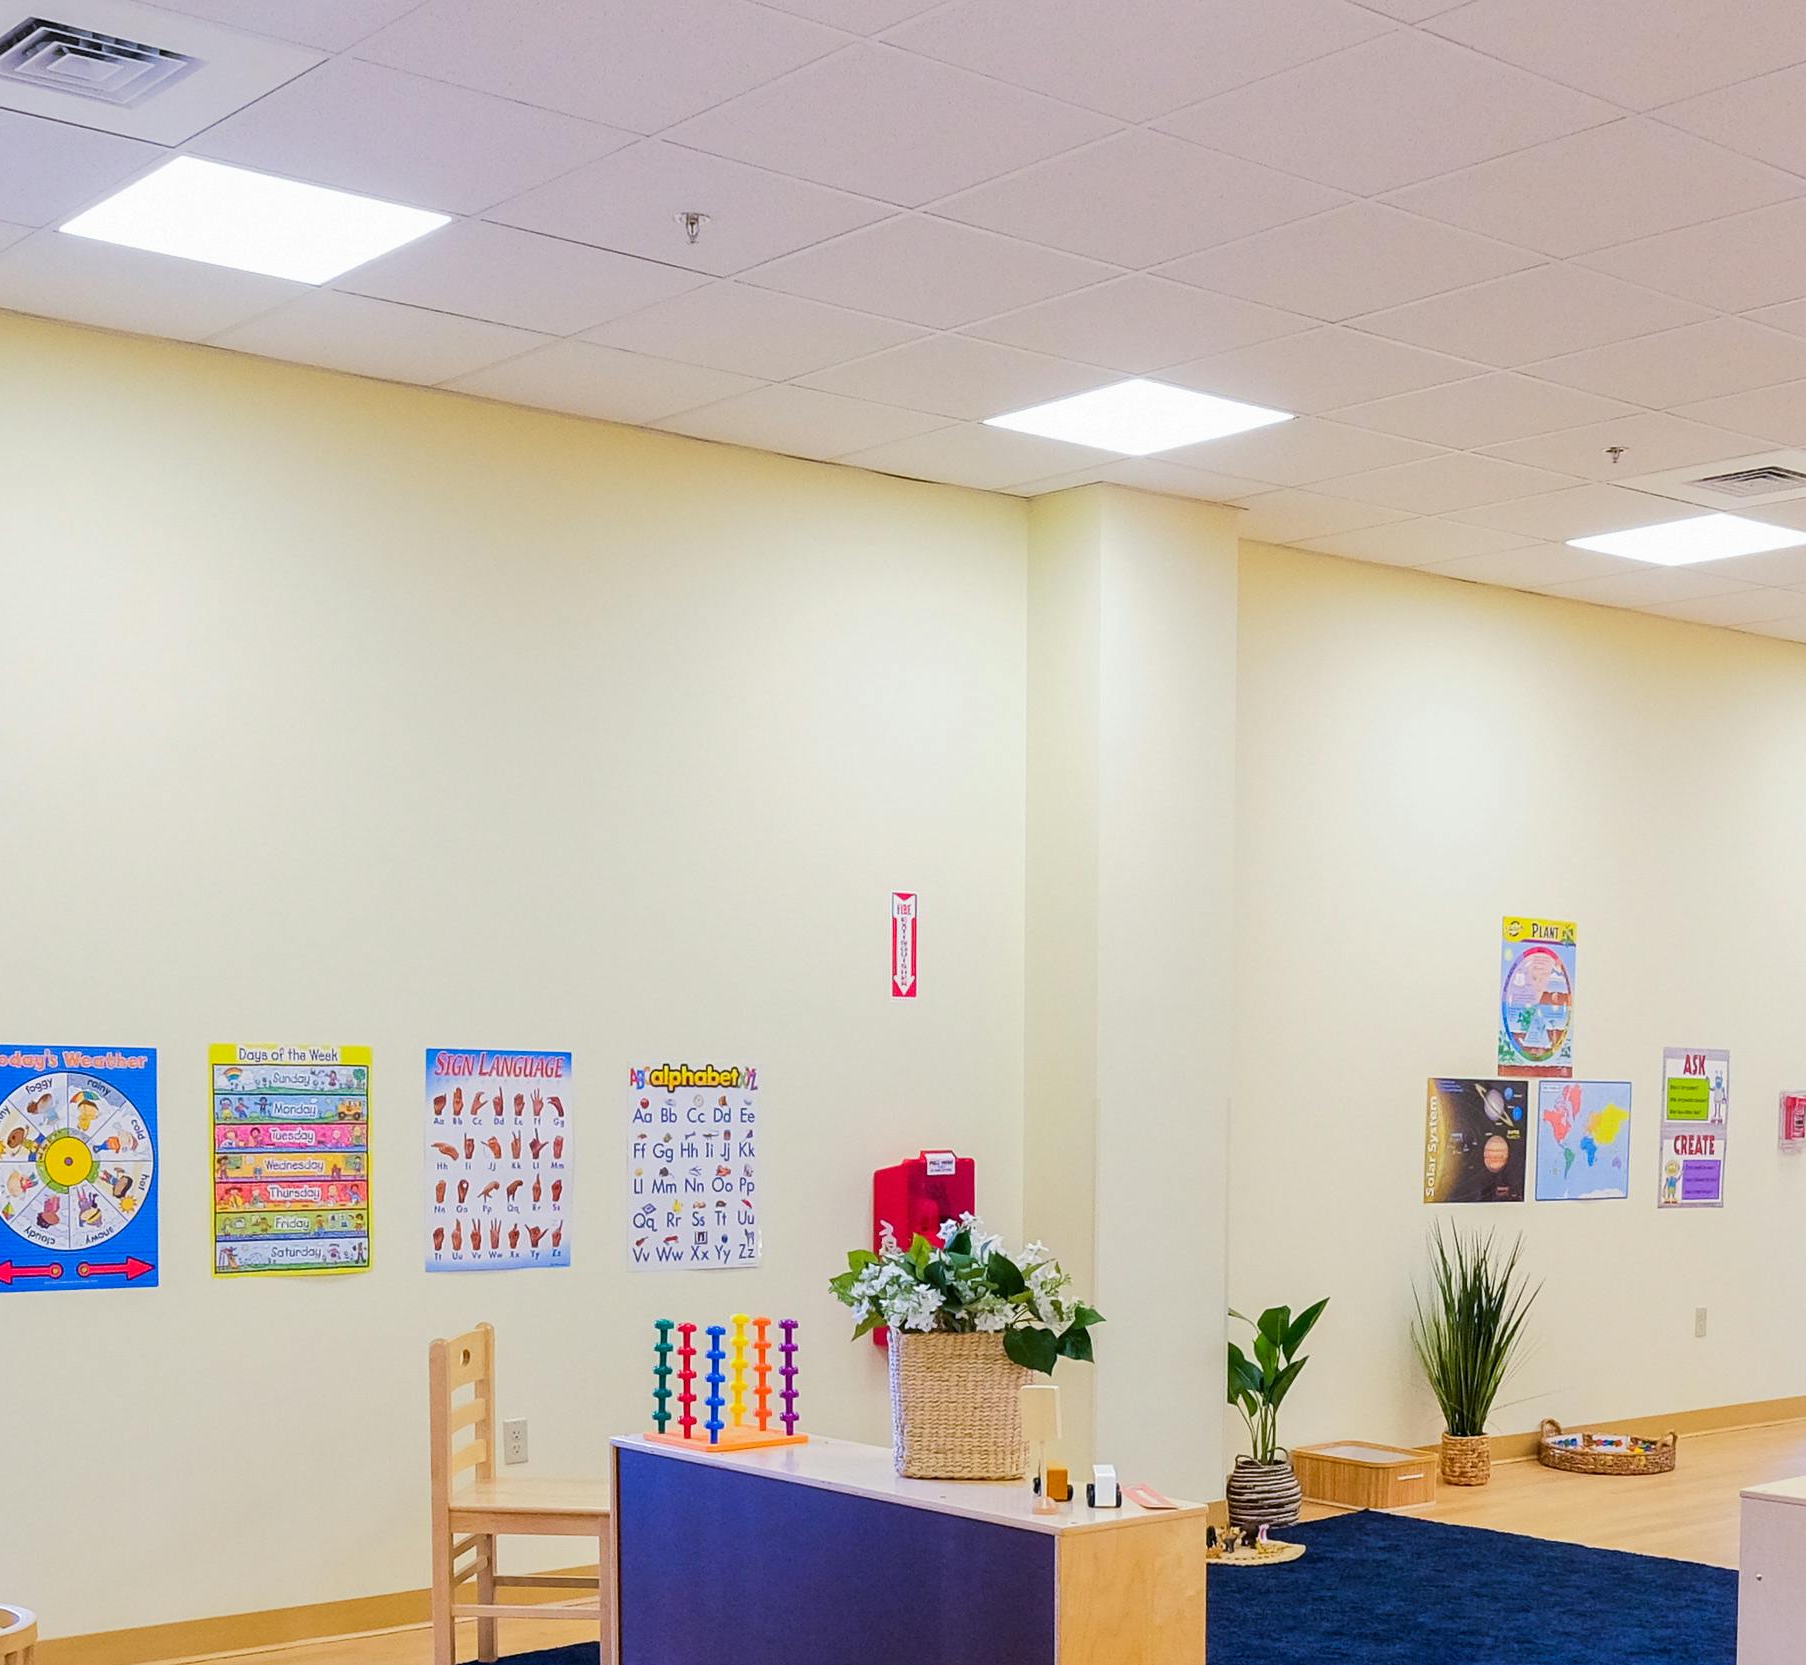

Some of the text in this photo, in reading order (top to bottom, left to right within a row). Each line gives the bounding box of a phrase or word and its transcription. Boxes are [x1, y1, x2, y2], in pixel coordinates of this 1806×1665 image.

[1532, 922, 1559, 939] PLANT
[62, 1051, 148, 1070] Weather
[239, 1047, 338, 1063] Days of the Week
[435, 1051, 564, 1078] SIGN LANGUAGE
[1683, 1054, 1706, 1075] ASK
[25, 1077, 53, 1095] foggy
[87, 1078, 112, 1097] rainy
[273, 1072, 310, 1086] Sunday
[650, 1063, 741, 1093] alphabet
[273, 1103, 316, 1117] Monday
[633, 1108, 755, 1123] Aa Bb Cc Dd Ee
[131, 1118, 145, 1141] cold
[271, 1129, 314, 1143] Tuesday
[633, 1142, 755, 1163] Ff Gg Hh Ii Jj Kk
[1425, 1096, 1438, 1198] Solar System
[1674, 1135, 1715, 1155] CREATE
[265, 1160, 324, 1173] Wednesday
[140, 1173, 151, 1191] hot
[634, 1177, 755, 1196] Ll Mm Nn Oo Pp
[269, 1187, 320, 1200] Thursday
[275, 1217, 310, 1230] Friday
[633, 1210, 755, 1232] Qq Rr Ss Tt Uu
[23, 1225, 56, 1246] cloudy
[85, 1226, 114, 1245] snowy
[271, 1246, 322, 1260] Saturday
[633, 1244, 755, 1264] Vv Ww Xx Yy Zz
